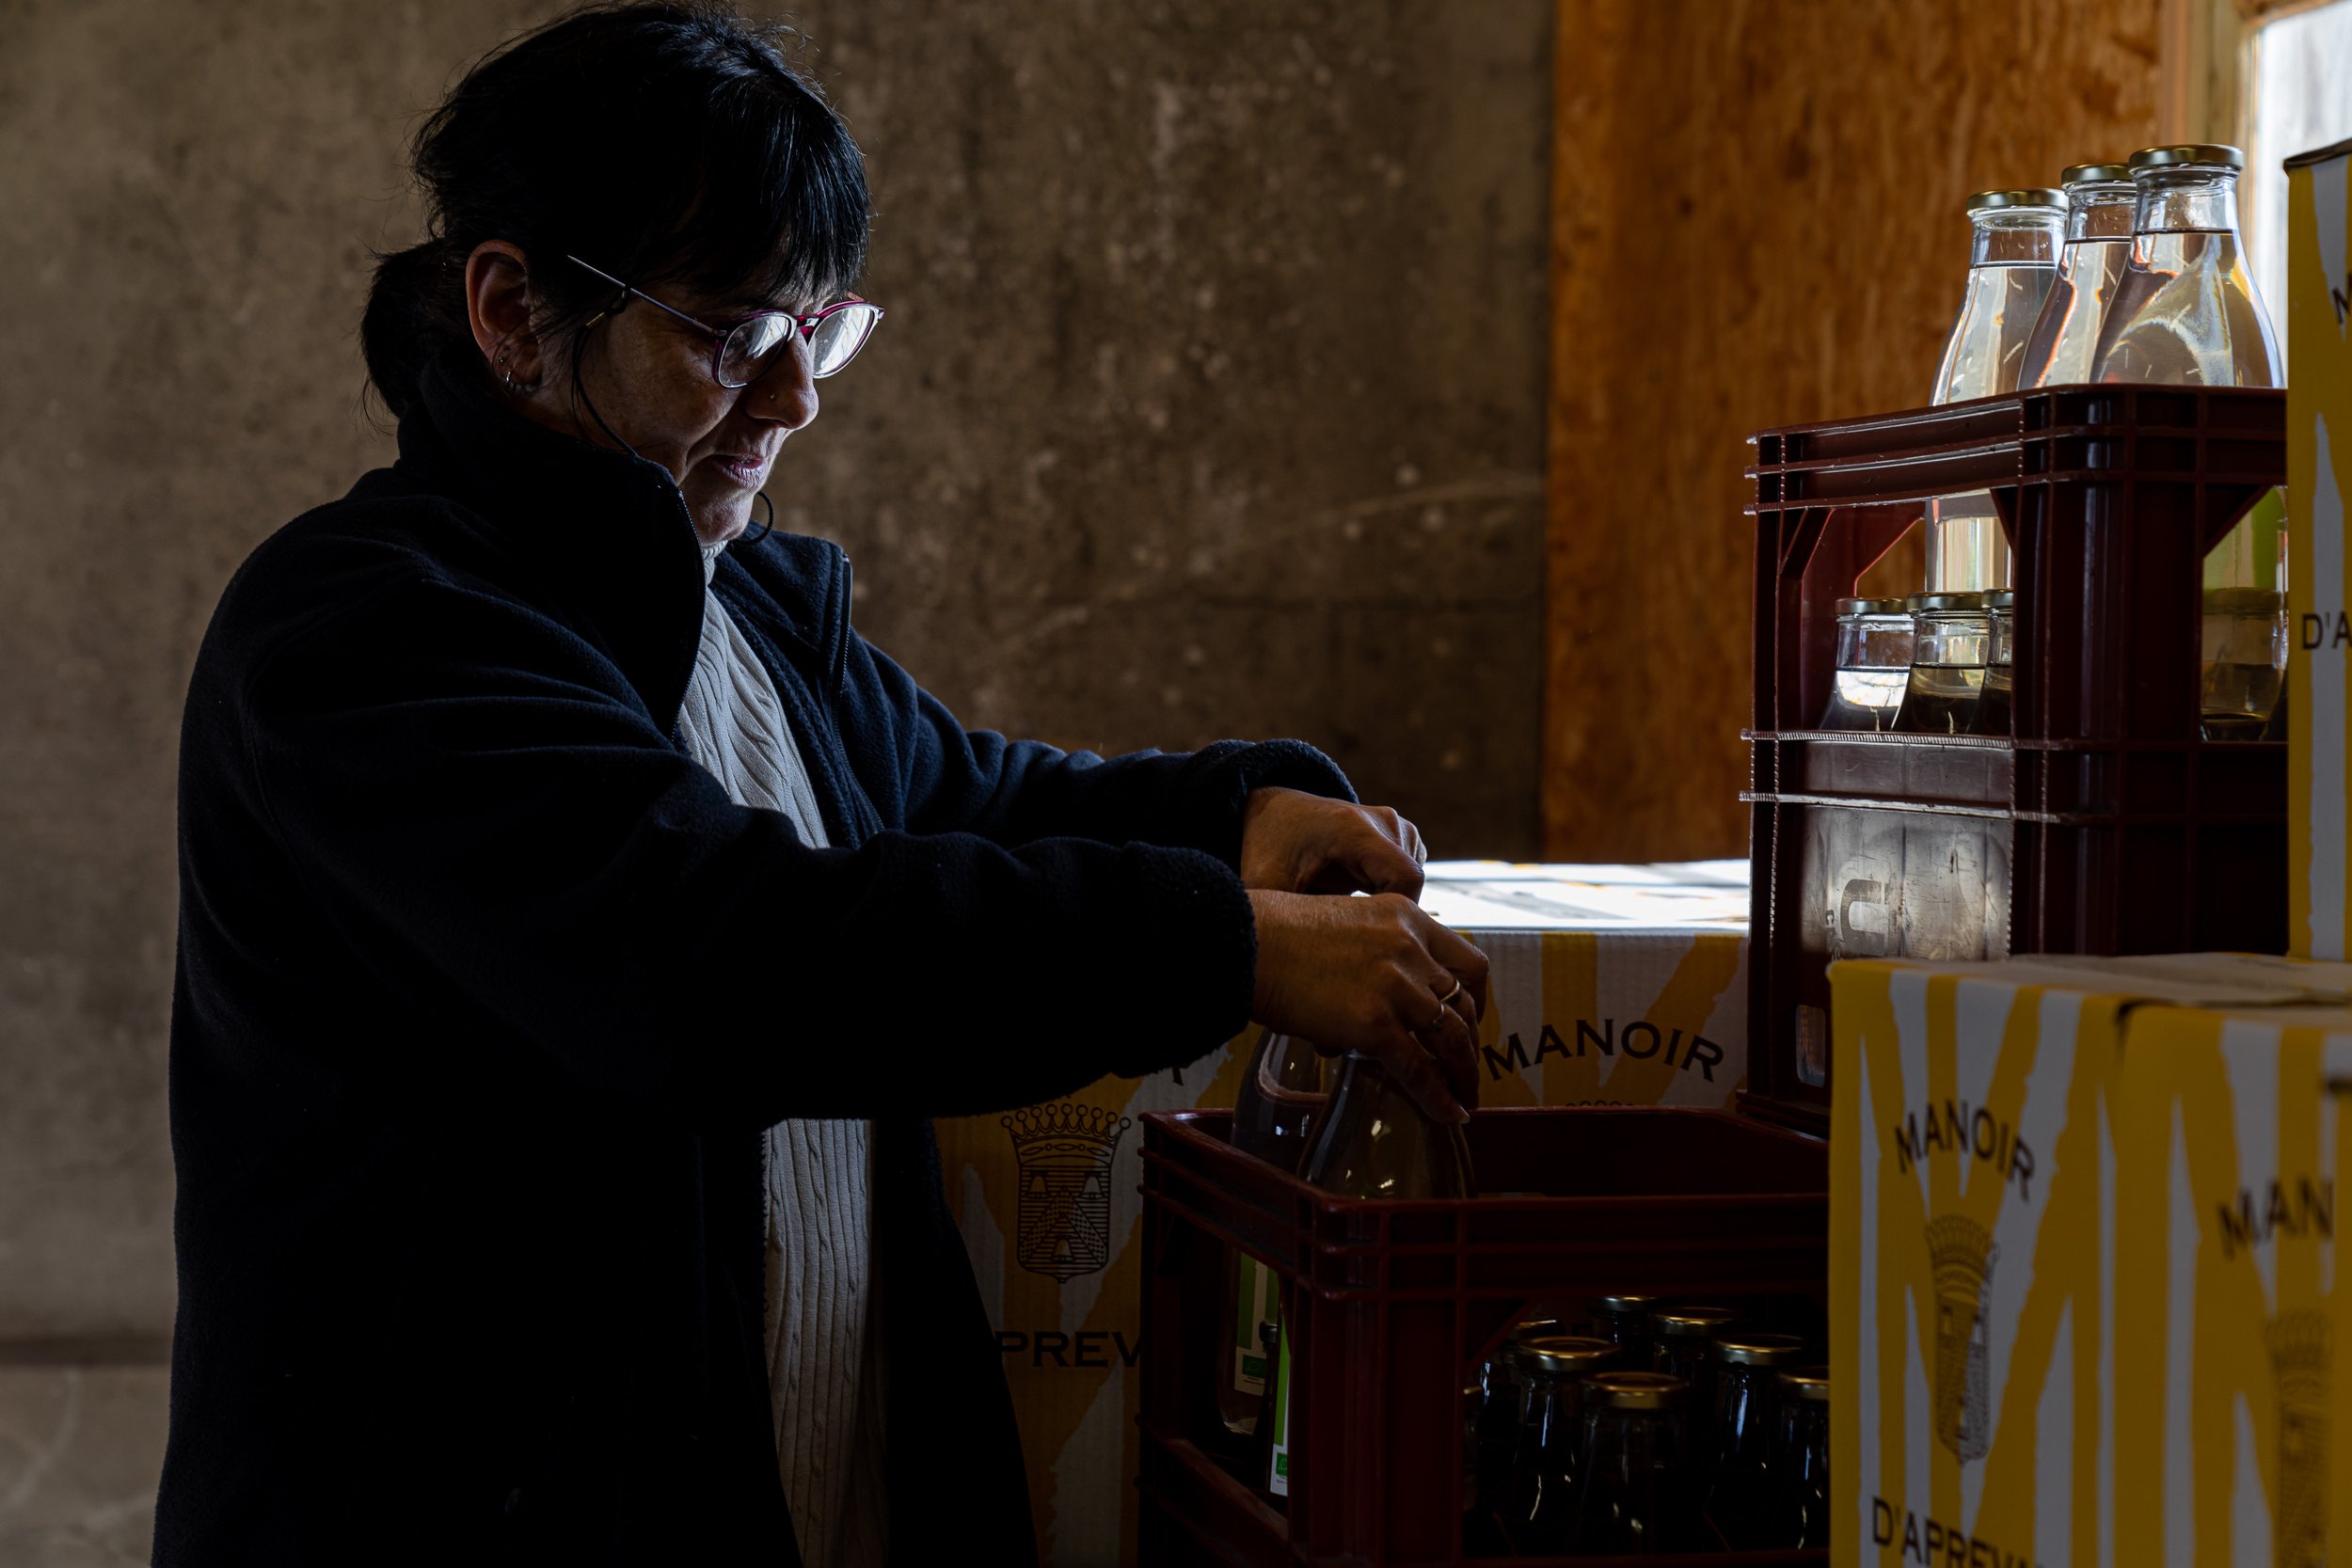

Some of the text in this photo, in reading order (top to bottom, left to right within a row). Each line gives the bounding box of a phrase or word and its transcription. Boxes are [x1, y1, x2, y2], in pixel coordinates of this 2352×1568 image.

[1481, 1019, 1724, 1082] MANOIR
[1895, 1099, 2035, 1203] MANOIR
[2217, 1175, 2333, 1259] MAN
